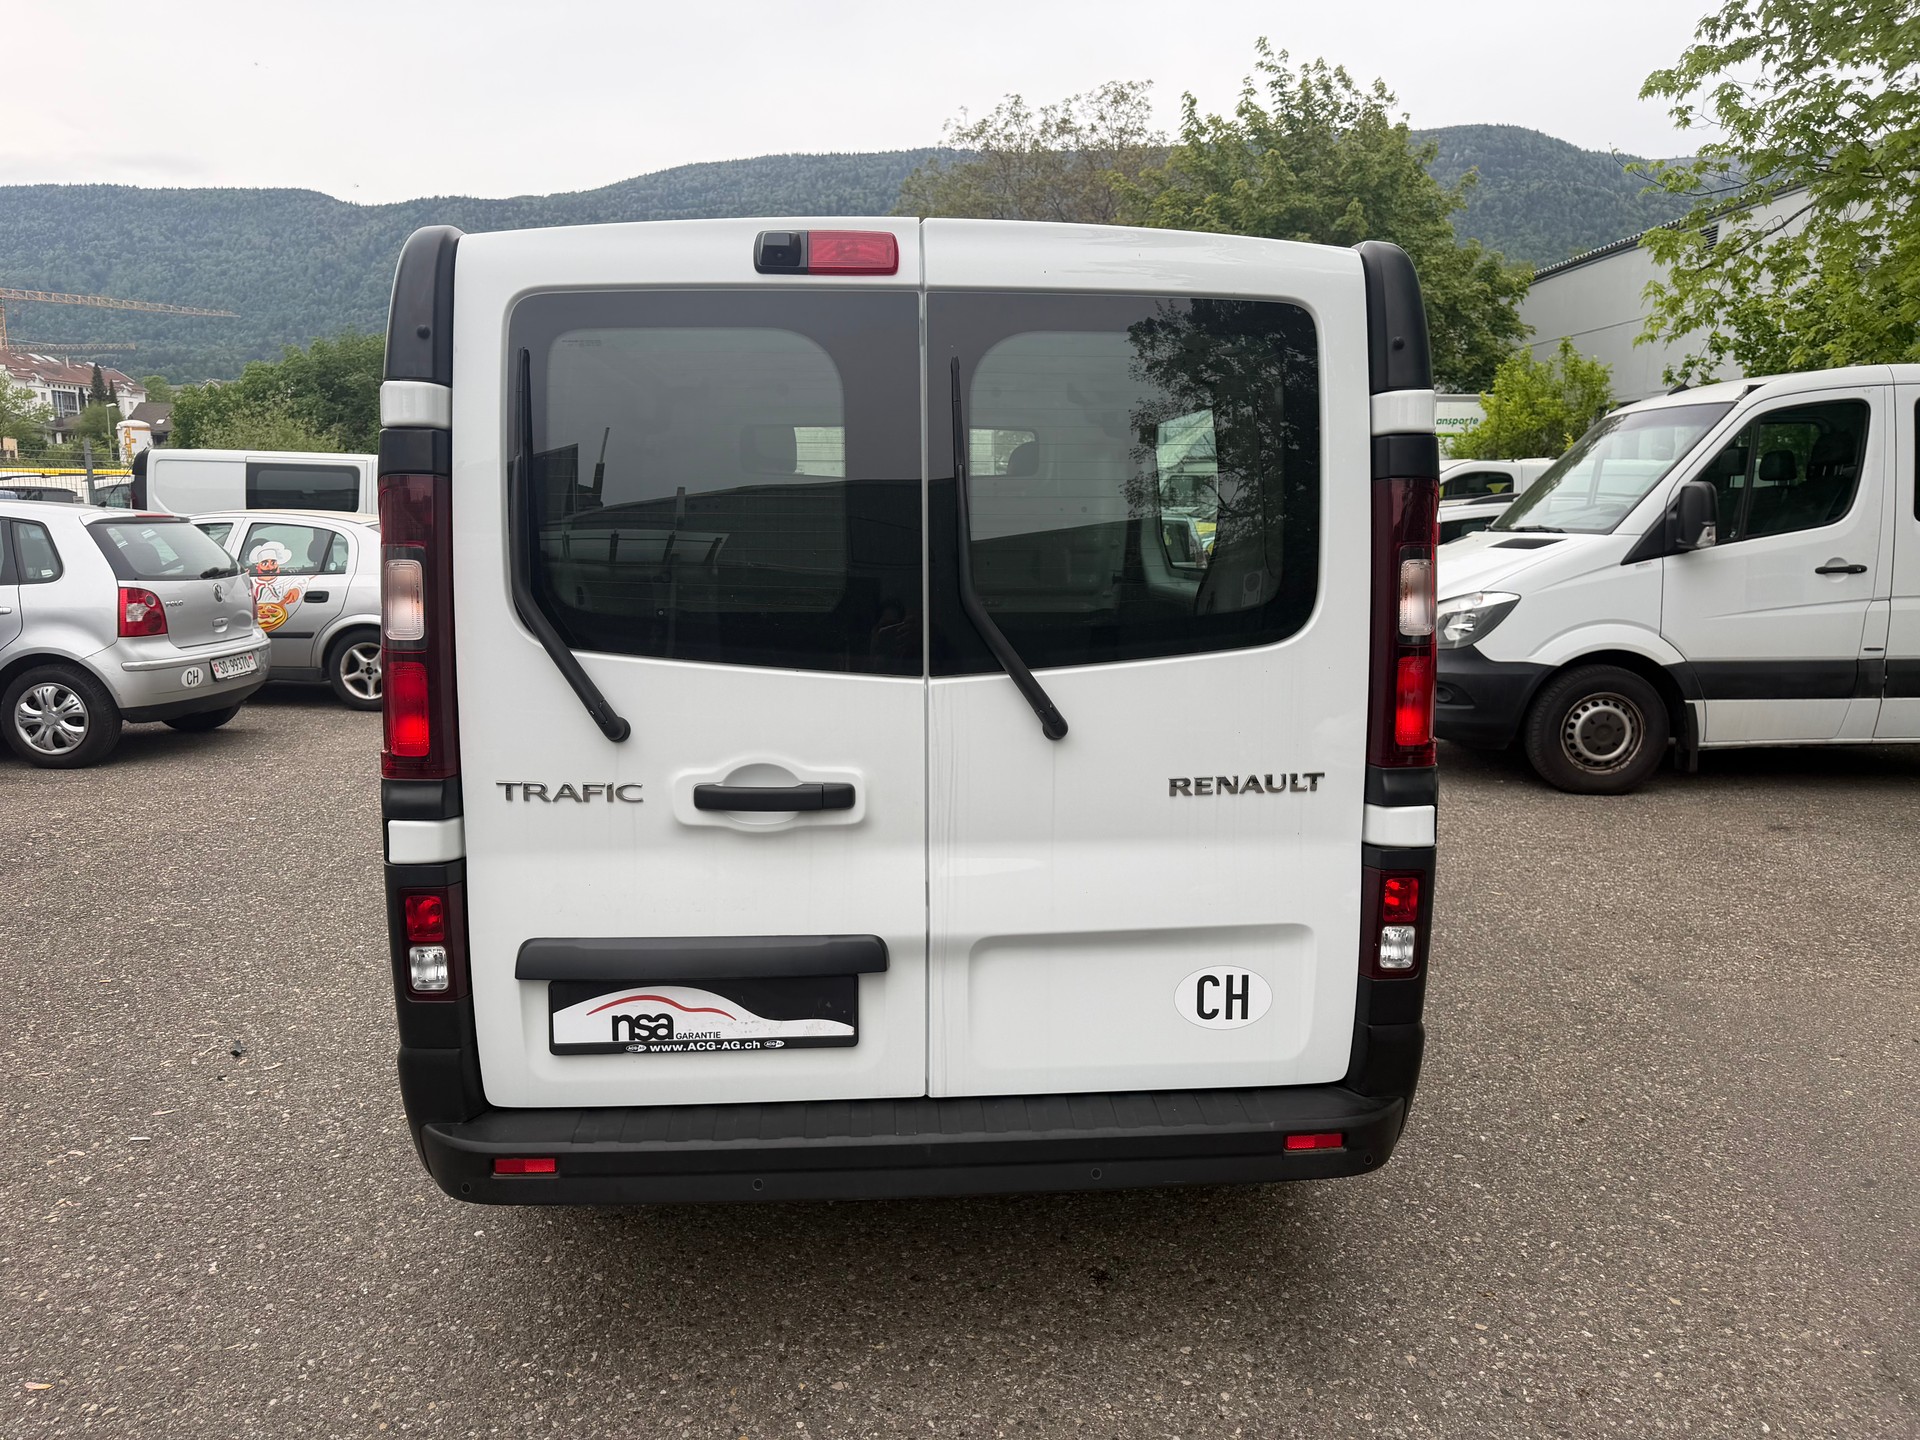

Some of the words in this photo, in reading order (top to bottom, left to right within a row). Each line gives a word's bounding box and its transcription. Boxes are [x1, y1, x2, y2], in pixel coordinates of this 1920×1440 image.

[186, 668, 199, 685] CH
[495, 780, 644, 803] TRAFIC
[1168, 772, 1326, 797] RENAULT
[1196, 974, 1249, 1020] CH
[612, 1013, 674, 1042] nsa
[675, 1031, 722, 1040] GARANTIE
[649, 1040, 761, 1053] www.ACG-AG.ch
